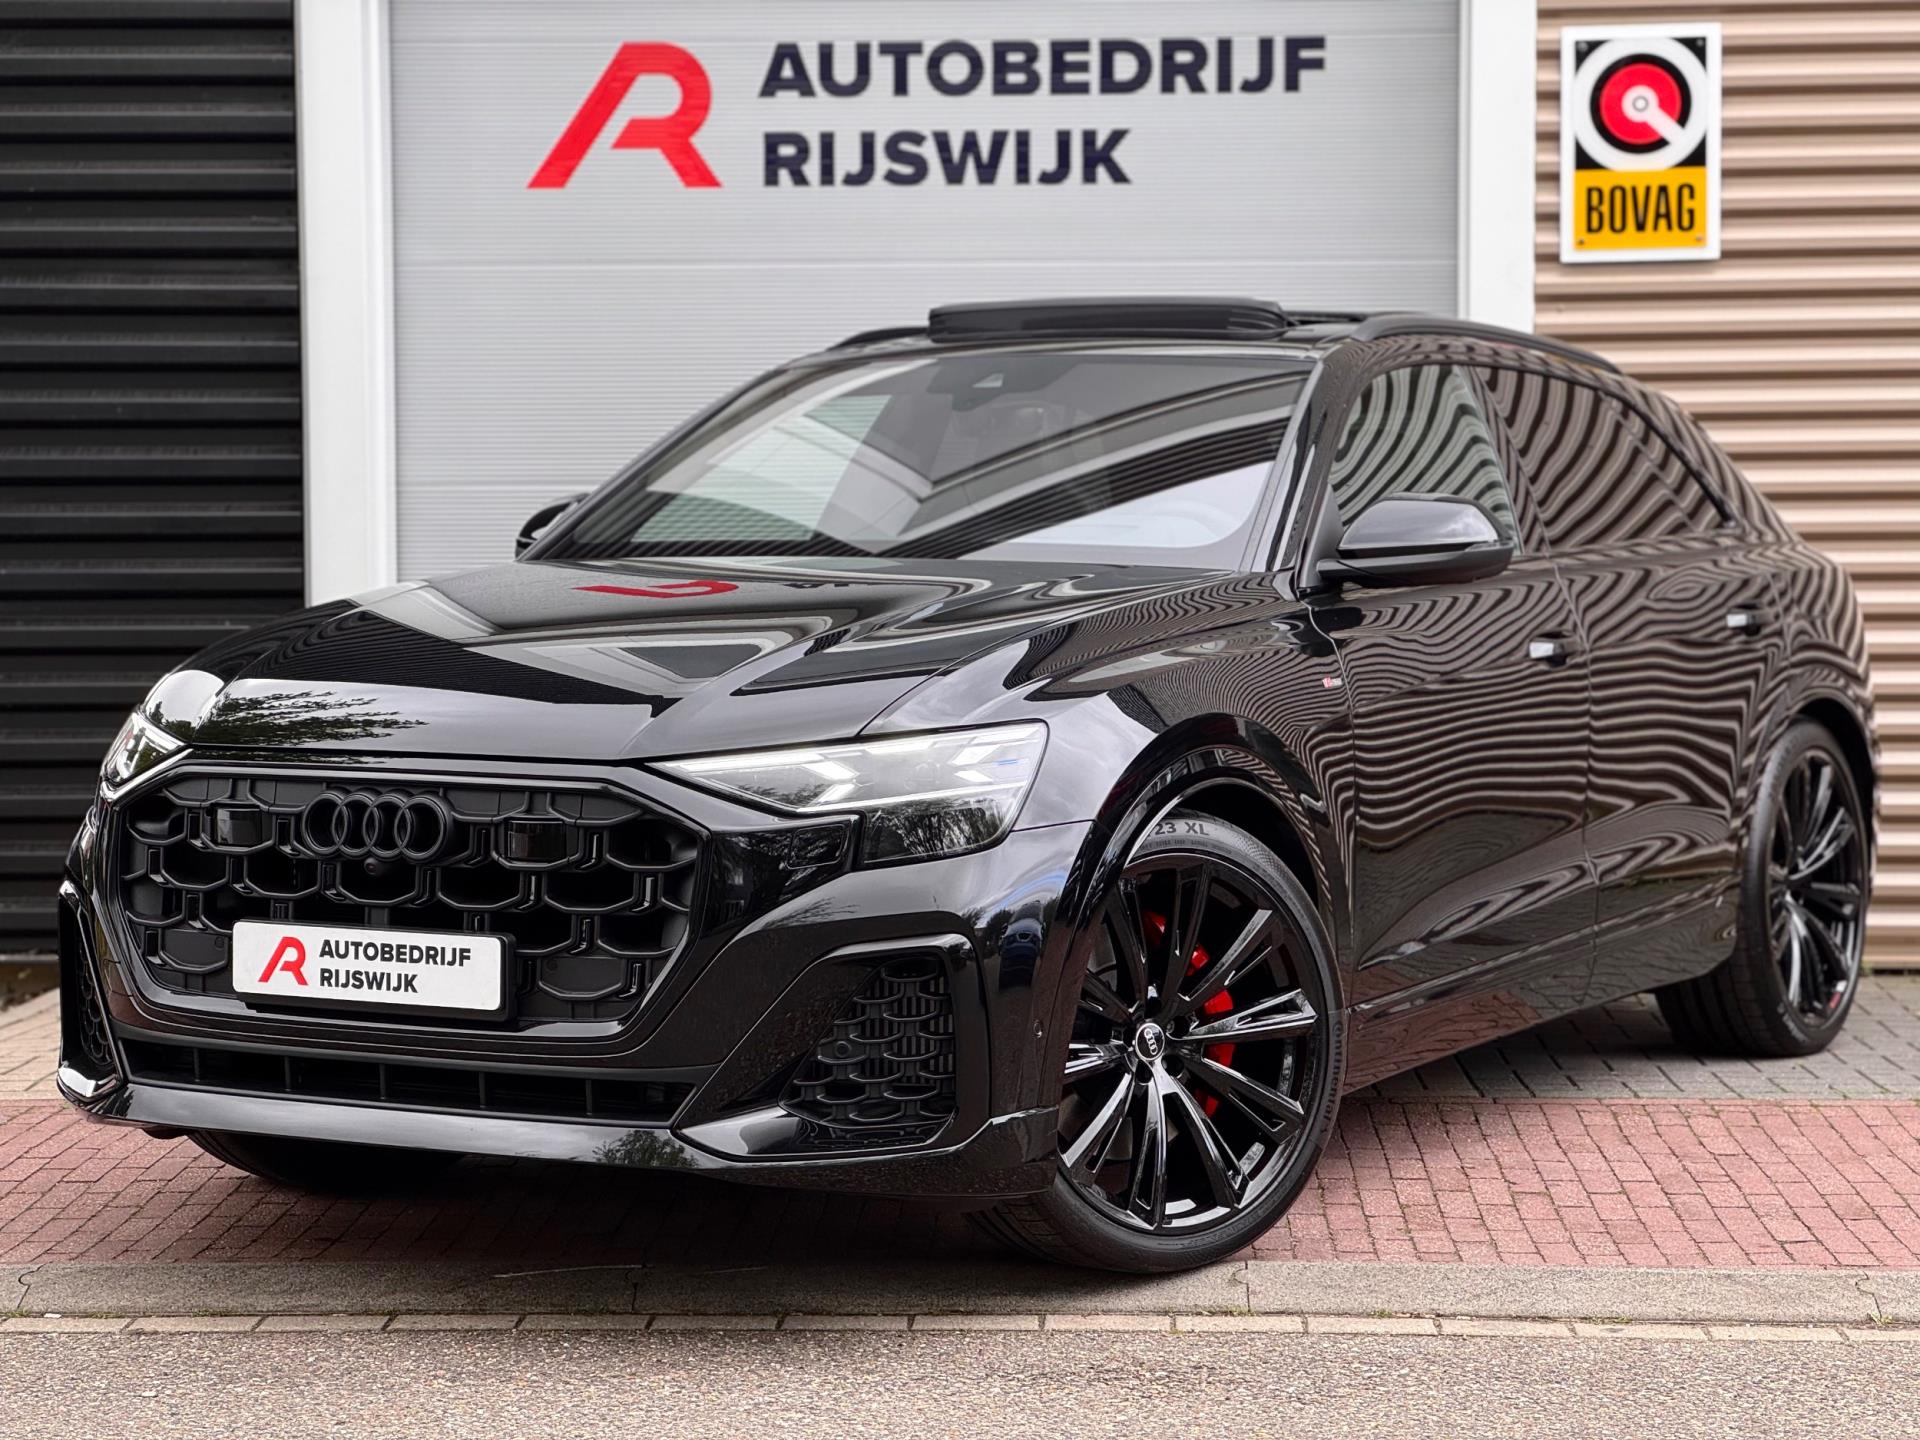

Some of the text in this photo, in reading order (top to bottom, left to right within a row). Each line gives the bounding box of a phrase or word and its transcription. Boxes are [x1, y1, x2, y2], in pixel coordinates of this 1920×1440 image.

[759, 36, 1326, 97] AUTOBEDRIJF
[763, 129, 1132, 187] RIJSWIJK
[1585, 183, 1696, 234] BOVAG
[1184, 821, 1210, 836] XL
[319, 939, 471, 967] AUTOBEDRIJF
[320, 968, 418, 993] RIJSWIJK
